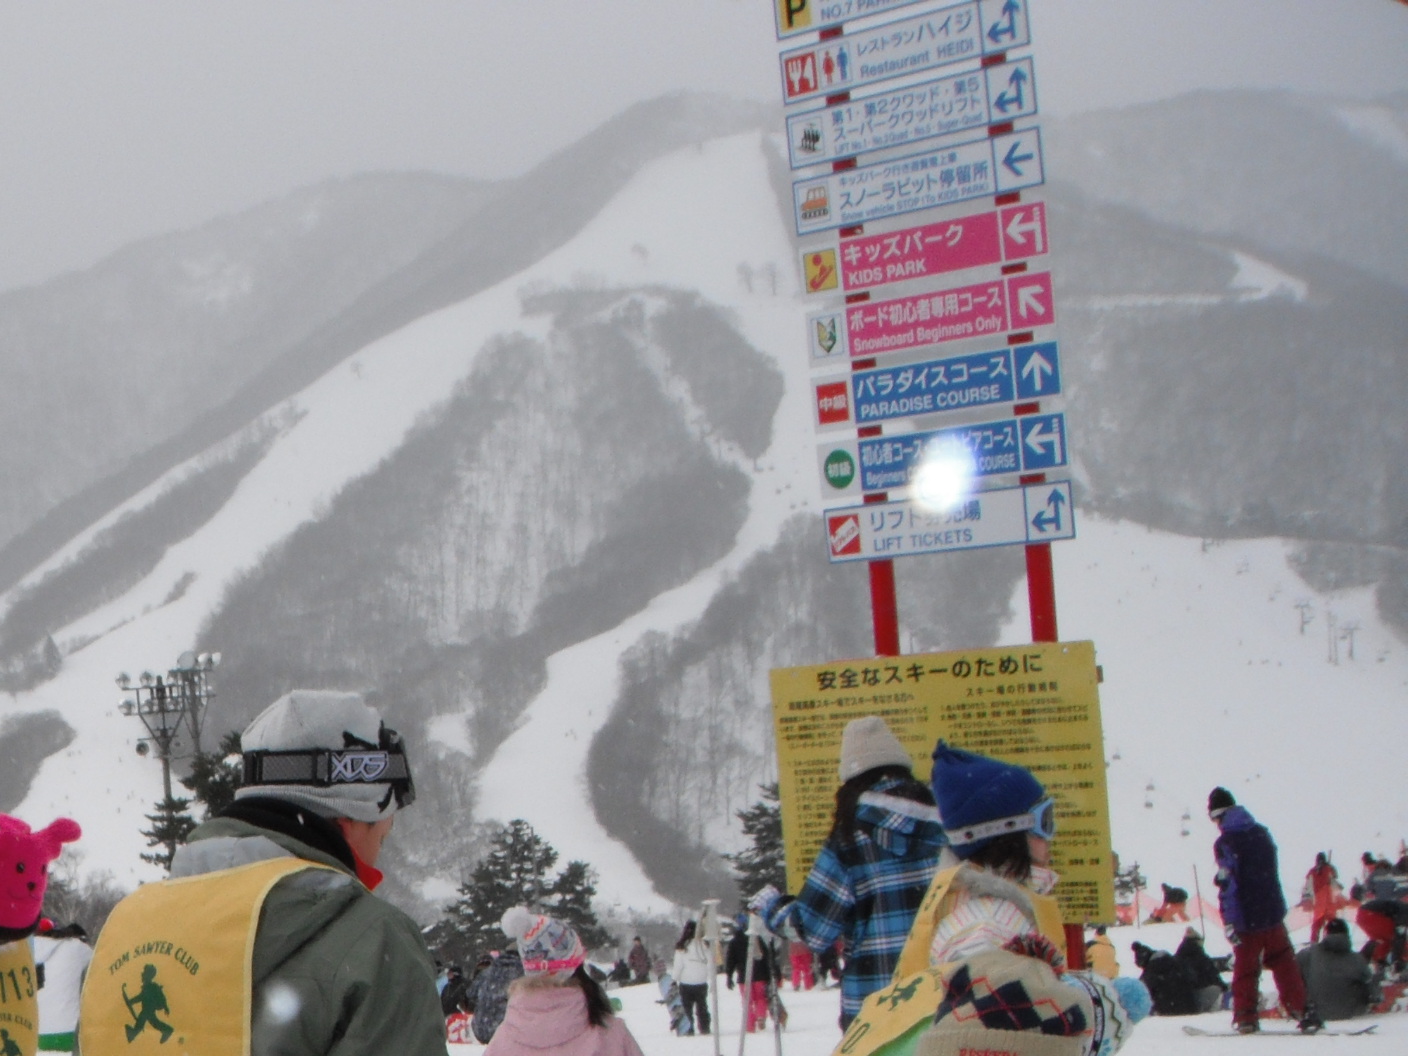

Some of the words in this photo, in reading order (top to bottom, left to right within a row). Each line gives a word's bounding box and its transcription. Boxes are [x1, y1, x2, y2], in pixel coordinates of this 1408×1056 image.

[856, 8, 973, 56] レストランハイジ
[859, 51, 930, 78] Restaurant
[936, 38, 975, 58] HEIDI
[834, 94, 980, 141] スーパークワッドリフト
[844, 224, 963, 266] キッズパーク
[848, 267, 882, 286] KIDS
[886, 258, 926, 279] PARK
[850, 286, 1002, 331] ボード初心者専用コース
[853, 330, 914, 352] Snowboard
[917, 318, 973, 343] Beginners
[975, 316, 1002, 332] Only
[856, 356, 1008, 398] パラダイスコース
[860, 393, 933, 418] PARADISE
[937, 384, 1001, 406] COURSE
[979, 453, 1016, 468] COURSE
[873, 536, 903, 551] LIFT
[911, 528, 973, 548] TICKETS
[817, 653, 1043, 691] 安全なスキーのために
[108, 952, 130, 976] TOM
[133, 940, 174, 959] SAWYER
[174, 947, 200, 976] CLUB
